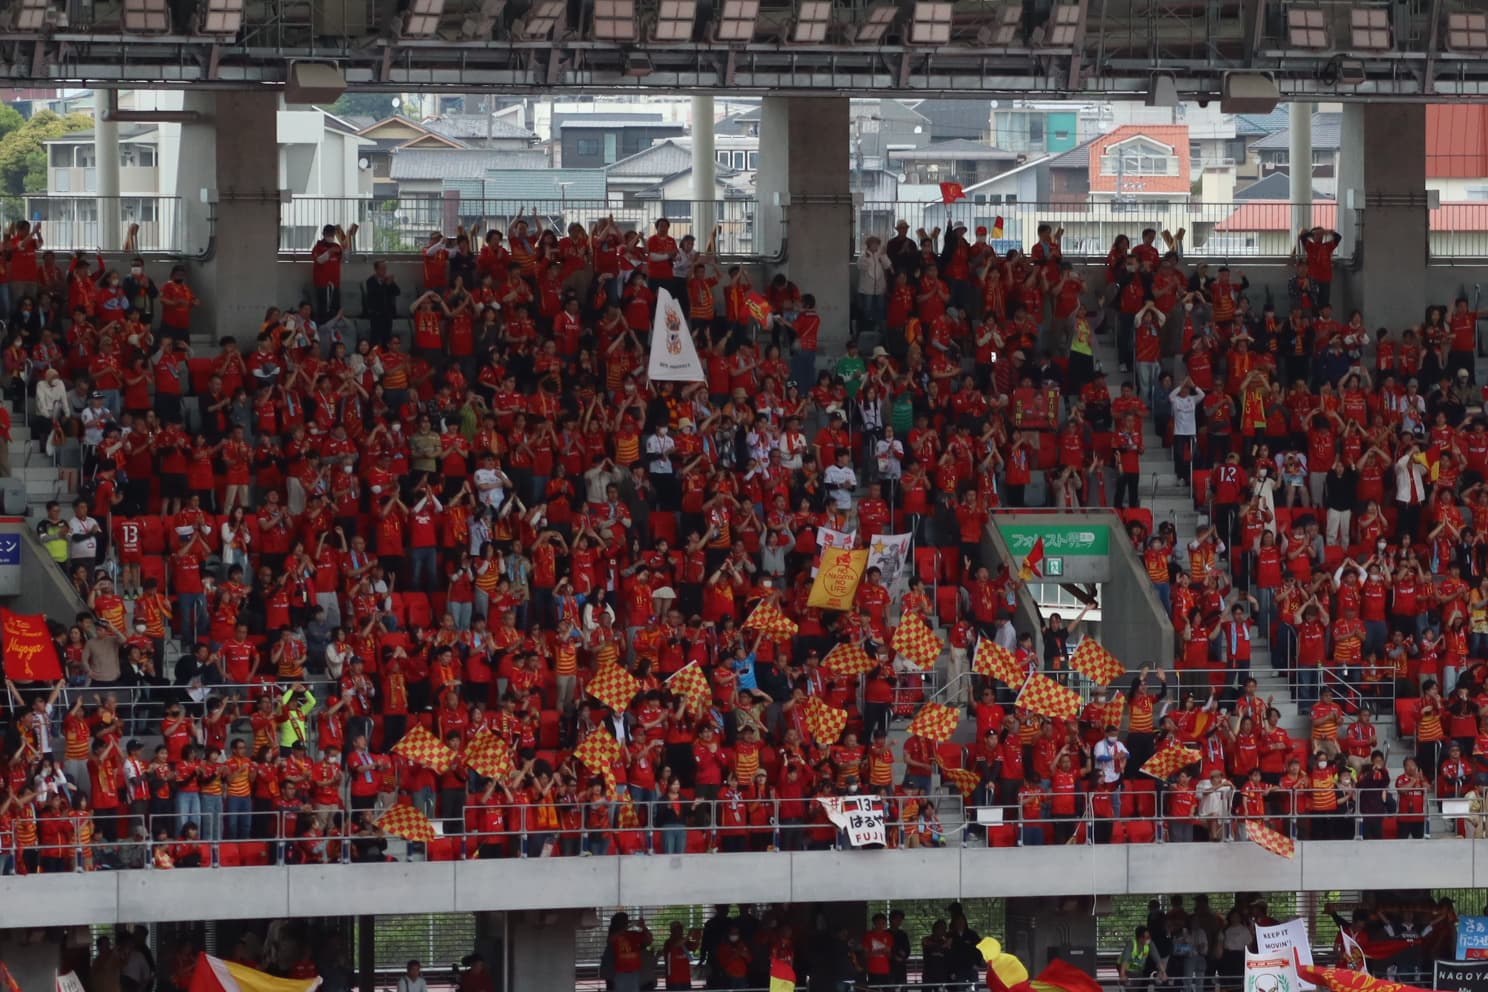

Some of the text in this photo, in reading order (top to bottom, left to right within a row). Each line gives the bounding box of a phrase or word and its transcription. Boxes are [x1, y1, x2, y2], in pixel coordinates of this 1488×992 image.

[122, 525, 138, 543] 13
[857, 798, 872, 811] 13
[849, 814, 885, 829] はるや
[855, 831, 884, 843] FUJI
[1262, 931, 1280, 939] KEEP
